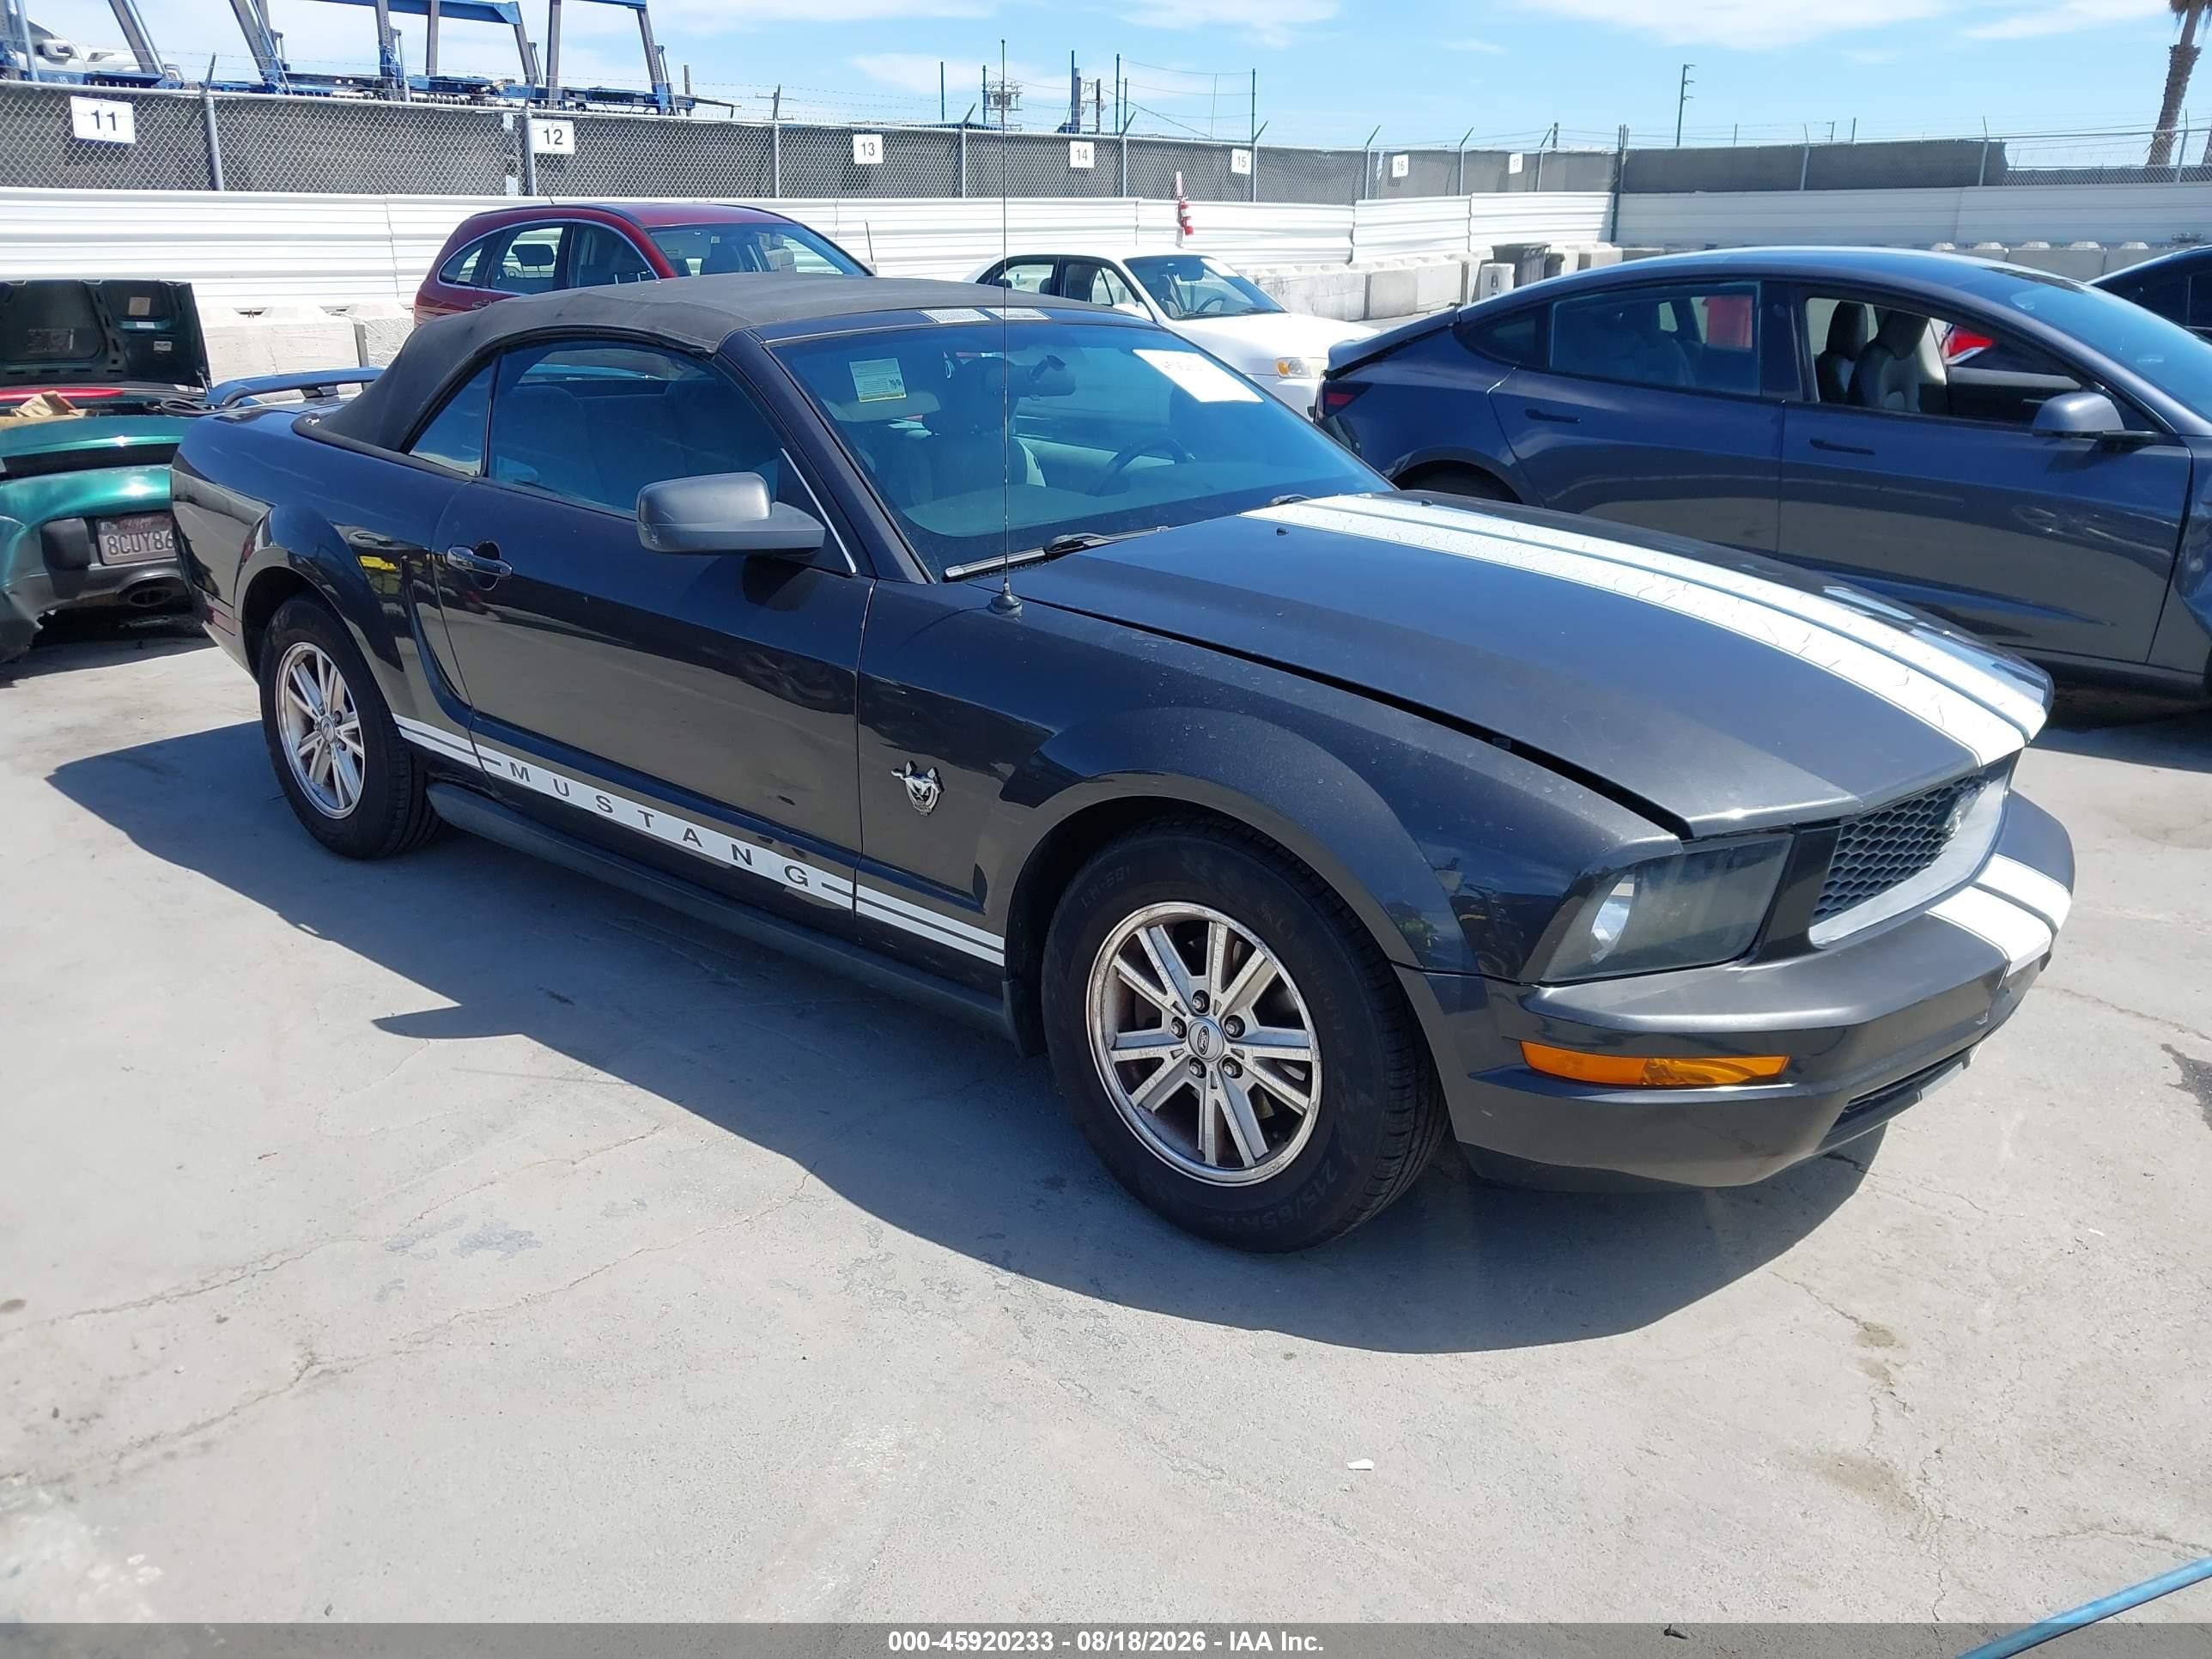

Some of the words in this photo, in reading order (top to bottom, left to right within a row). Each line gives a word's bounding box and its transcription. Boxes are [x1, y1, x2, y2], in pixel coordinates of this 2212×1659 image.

[90, 109, 117, 131] 11
[543, 127, 564, 145] 12
[860, 141, 875, 156] 13
[1075, 148, 1088, 161] 14
[1237, 155, 1247, 168] 15
[509, 761, 811, 888] MUSTANG
